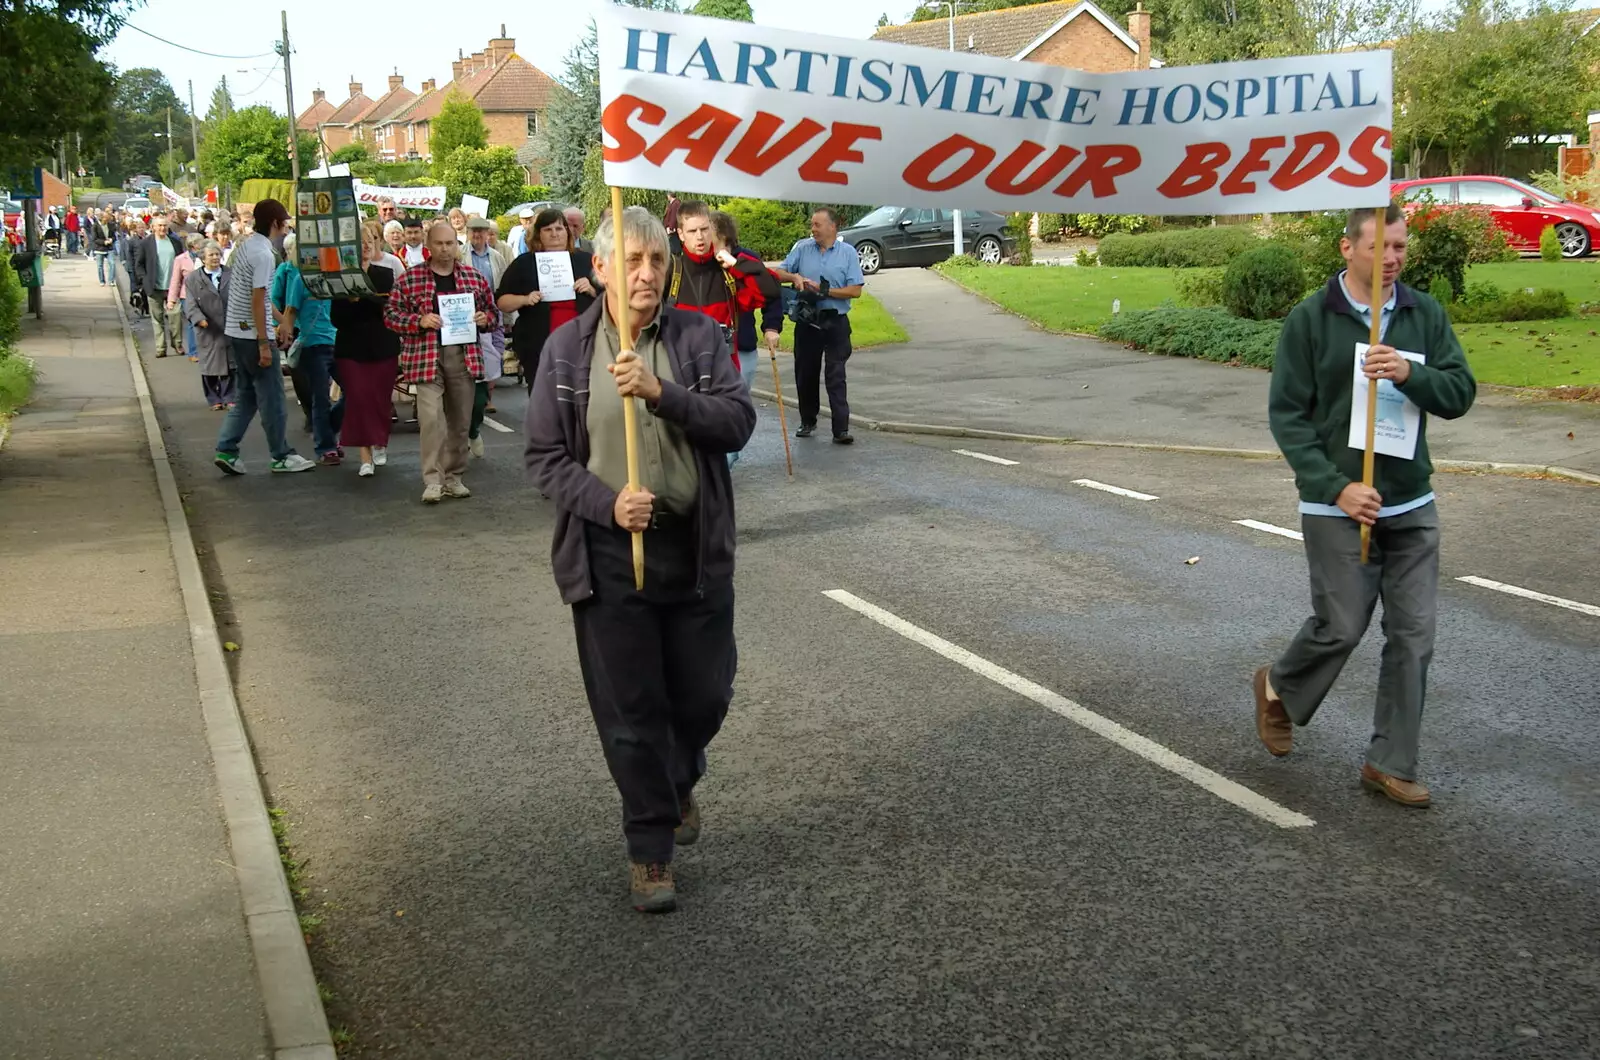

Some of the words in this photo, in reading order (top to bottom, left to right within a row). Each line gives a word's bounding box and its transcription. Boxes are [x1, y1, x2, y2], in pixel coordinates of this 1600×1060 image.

[620, 28, 1101, 125] HARTISMERE
[1113, 69, 1378, 125] HOSPITAL
[601, 94, 882, 186] SAVE
[902, 133, 1142, 199] OUR
[1156, 126, 1391, 199] BEDS
